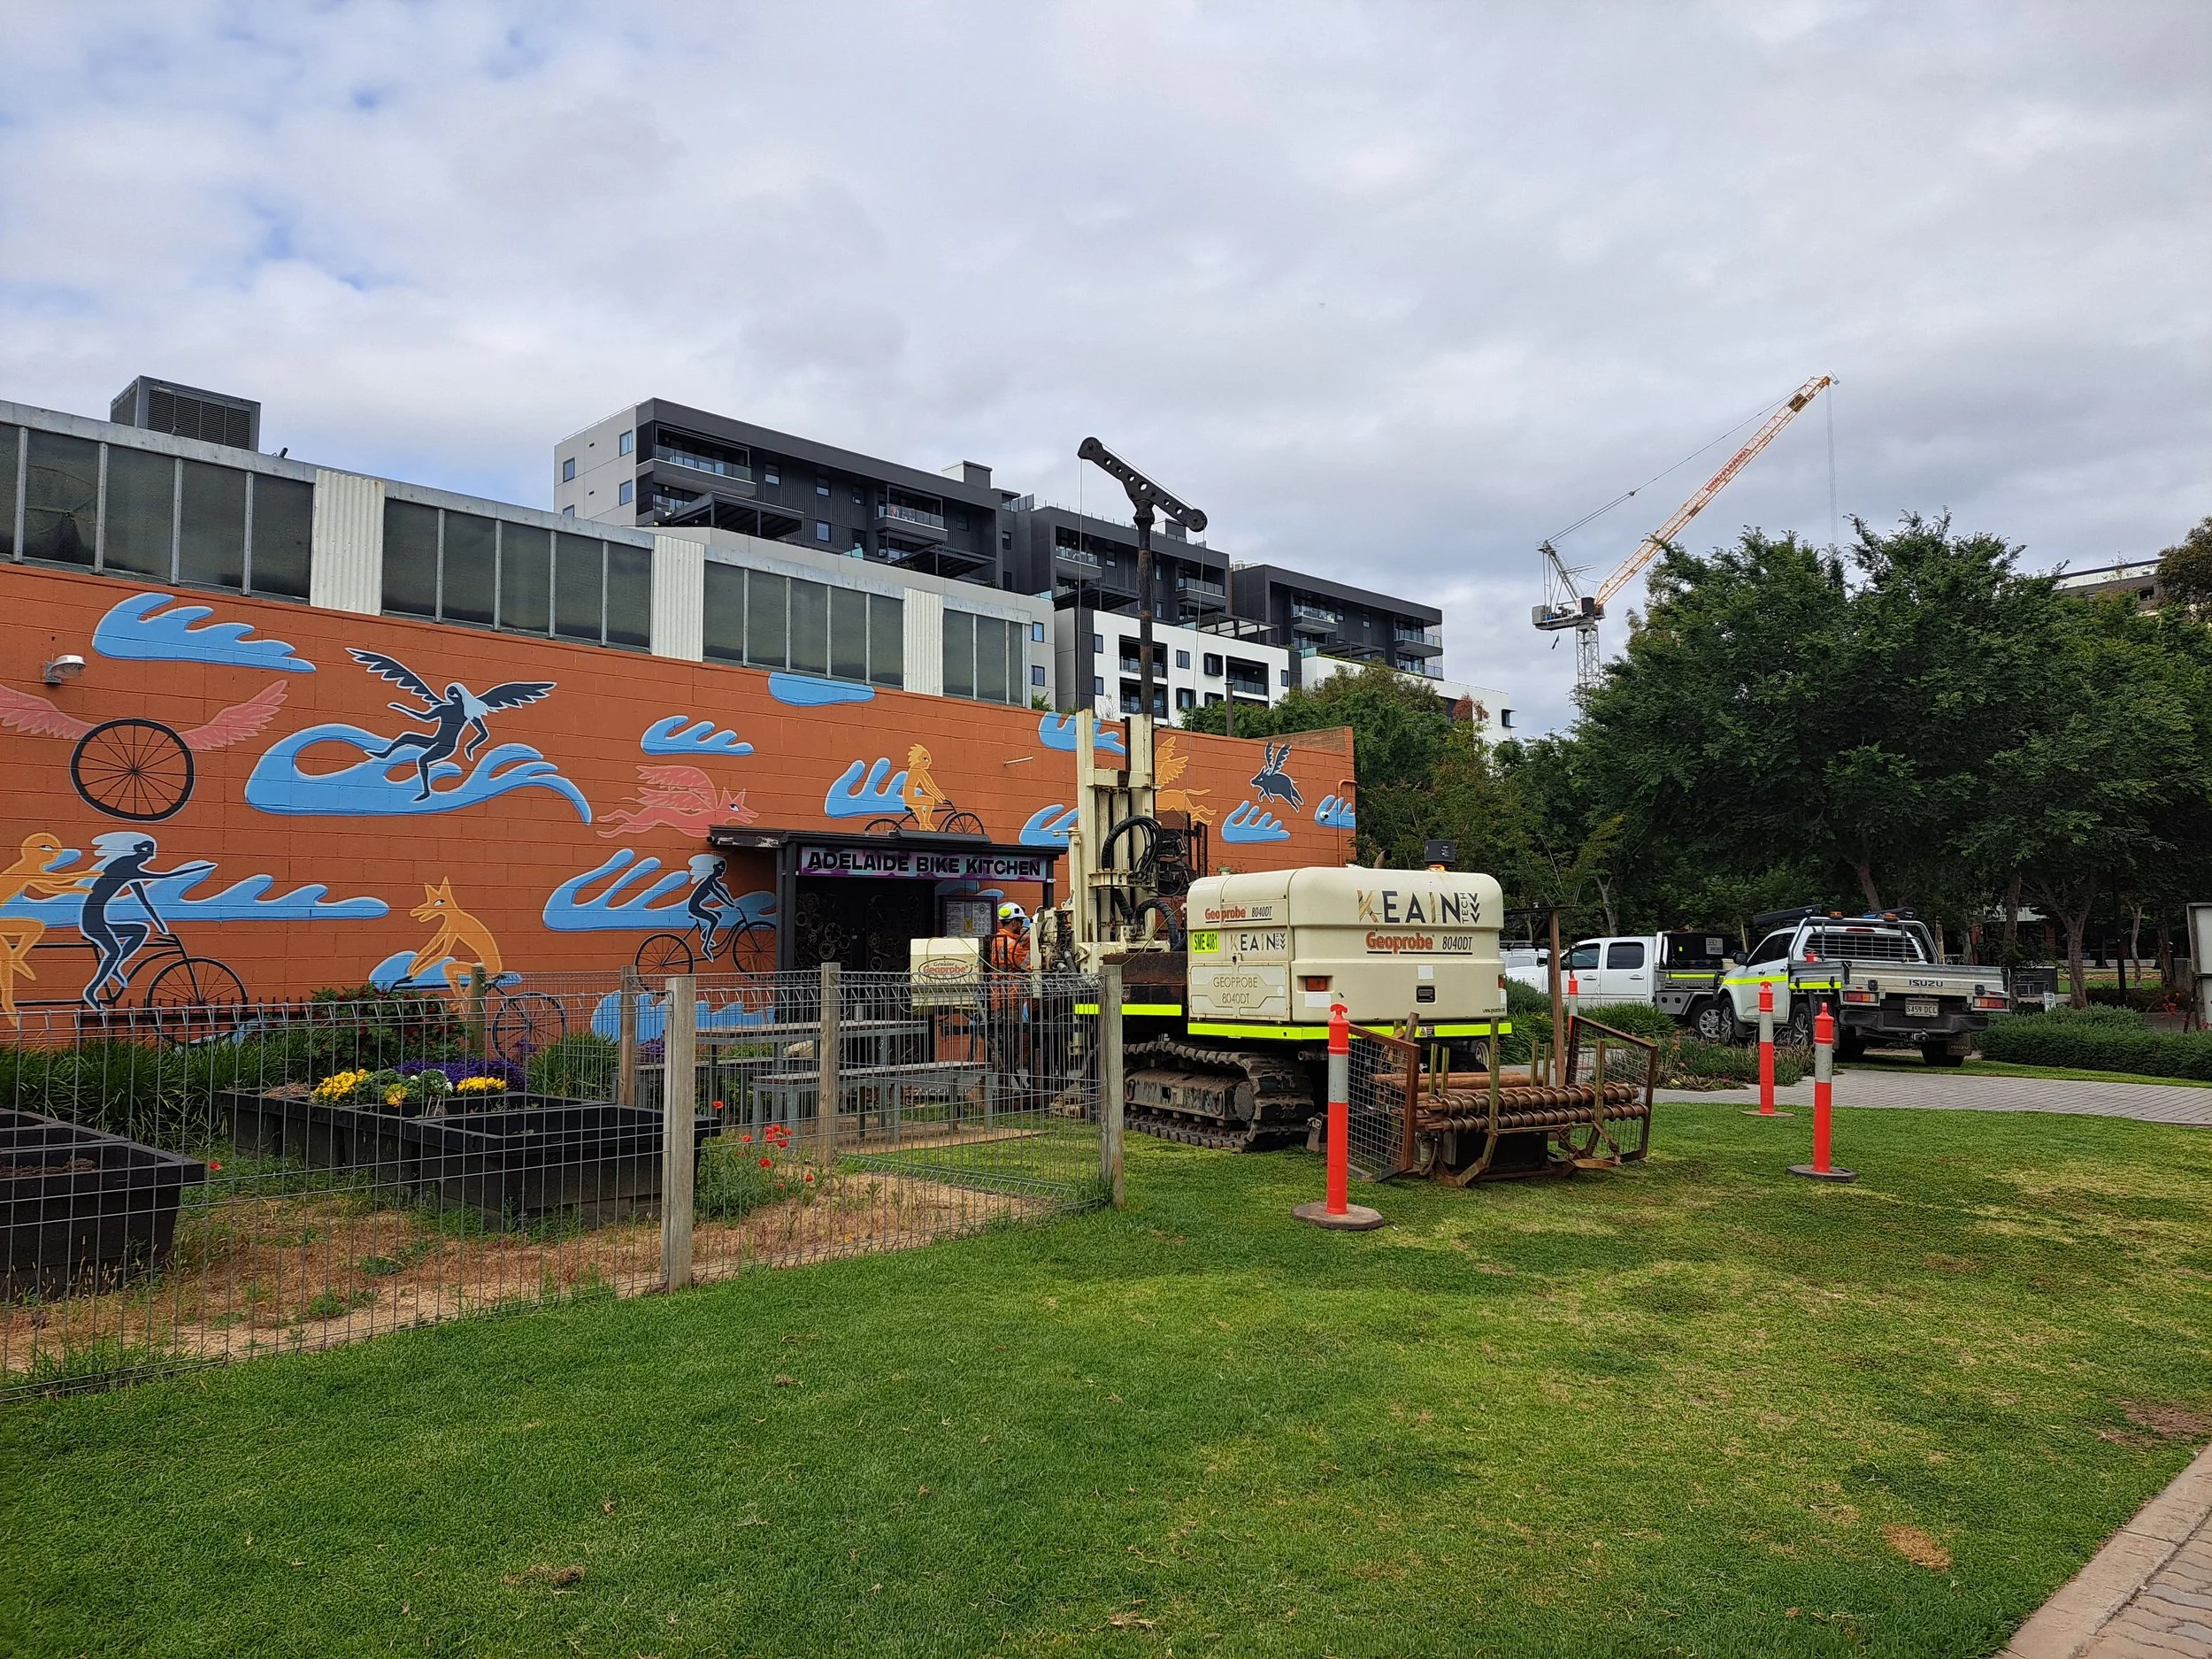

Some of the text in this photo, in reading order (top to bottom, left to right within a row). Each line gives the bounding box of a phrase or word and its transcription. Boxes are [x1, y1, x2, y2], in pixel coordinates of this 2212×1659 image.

[808, 851, 1041, 877] ADELAIDE BIKE KITCHEN
[1204, 906, 1272, 922] Geoprobe 8040DT
[1356, 889, 1462, 925] KEAIN
[1460, 892, 1469, 924] TECH
[1230, 933, 1275, 951] KEAIN
[1365, 932, 1473, 954] Geoprobe 8040DT
[1213, 977, 1257, 988] GEOPROBE
[1222, 993, 1250, 1004] 8040DT
